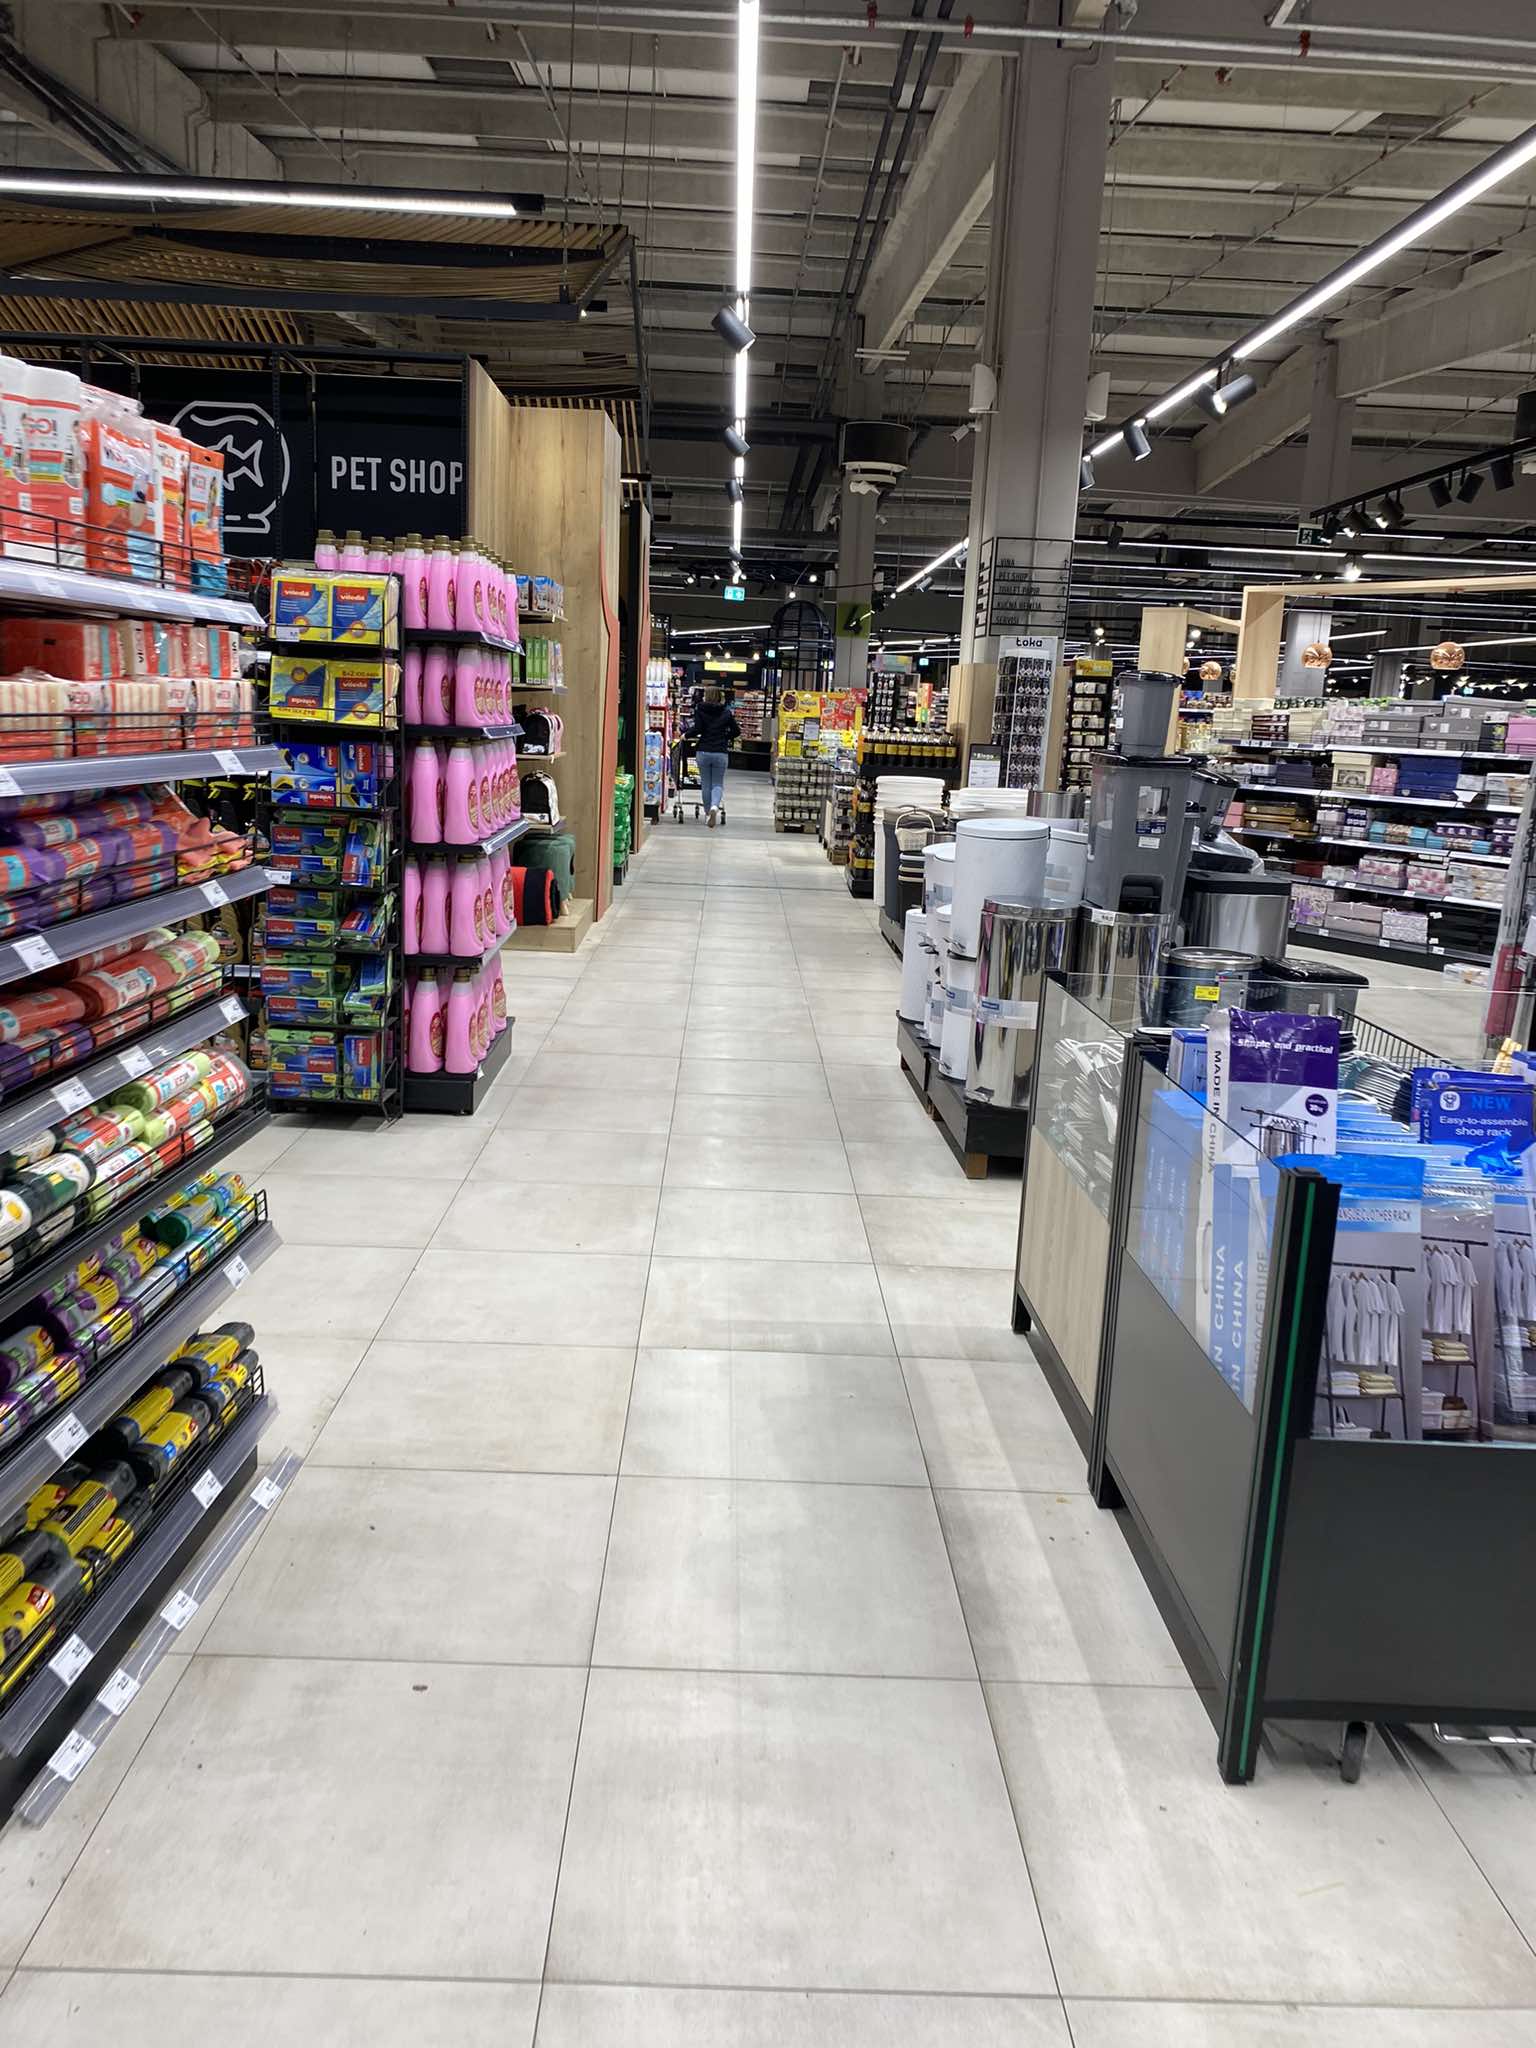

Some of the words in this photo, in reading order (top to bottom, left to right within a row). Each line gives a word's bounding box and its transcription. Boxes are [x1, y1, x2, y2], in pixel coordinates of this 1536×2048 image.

[331, 455, 382, 492] PET
[389, 458, 464, 495] SHOP
[1238, 1039, 1272, 1049] simple
[1274, 1041, 1293, 1050] and
[1294, 1043, 1334, 1054] practical
[1214, 1050, 1222, 1097] MADE
[1213, 1102, 1220, 1118] IN
[1471, 1094, 1512, 1111] NEW
[1439, 1115, 1529, 1127] Easy-to-assemble
[1455, 1127, 1485, 1137] shoe
[1486, 1127, 1513, 1137] rack
[1207, 1122, 1218, 1174] CHINA
[1214, 1244, 1226, 1331] CHINA
[1231, 1260, 1244, 1349] CHINA
